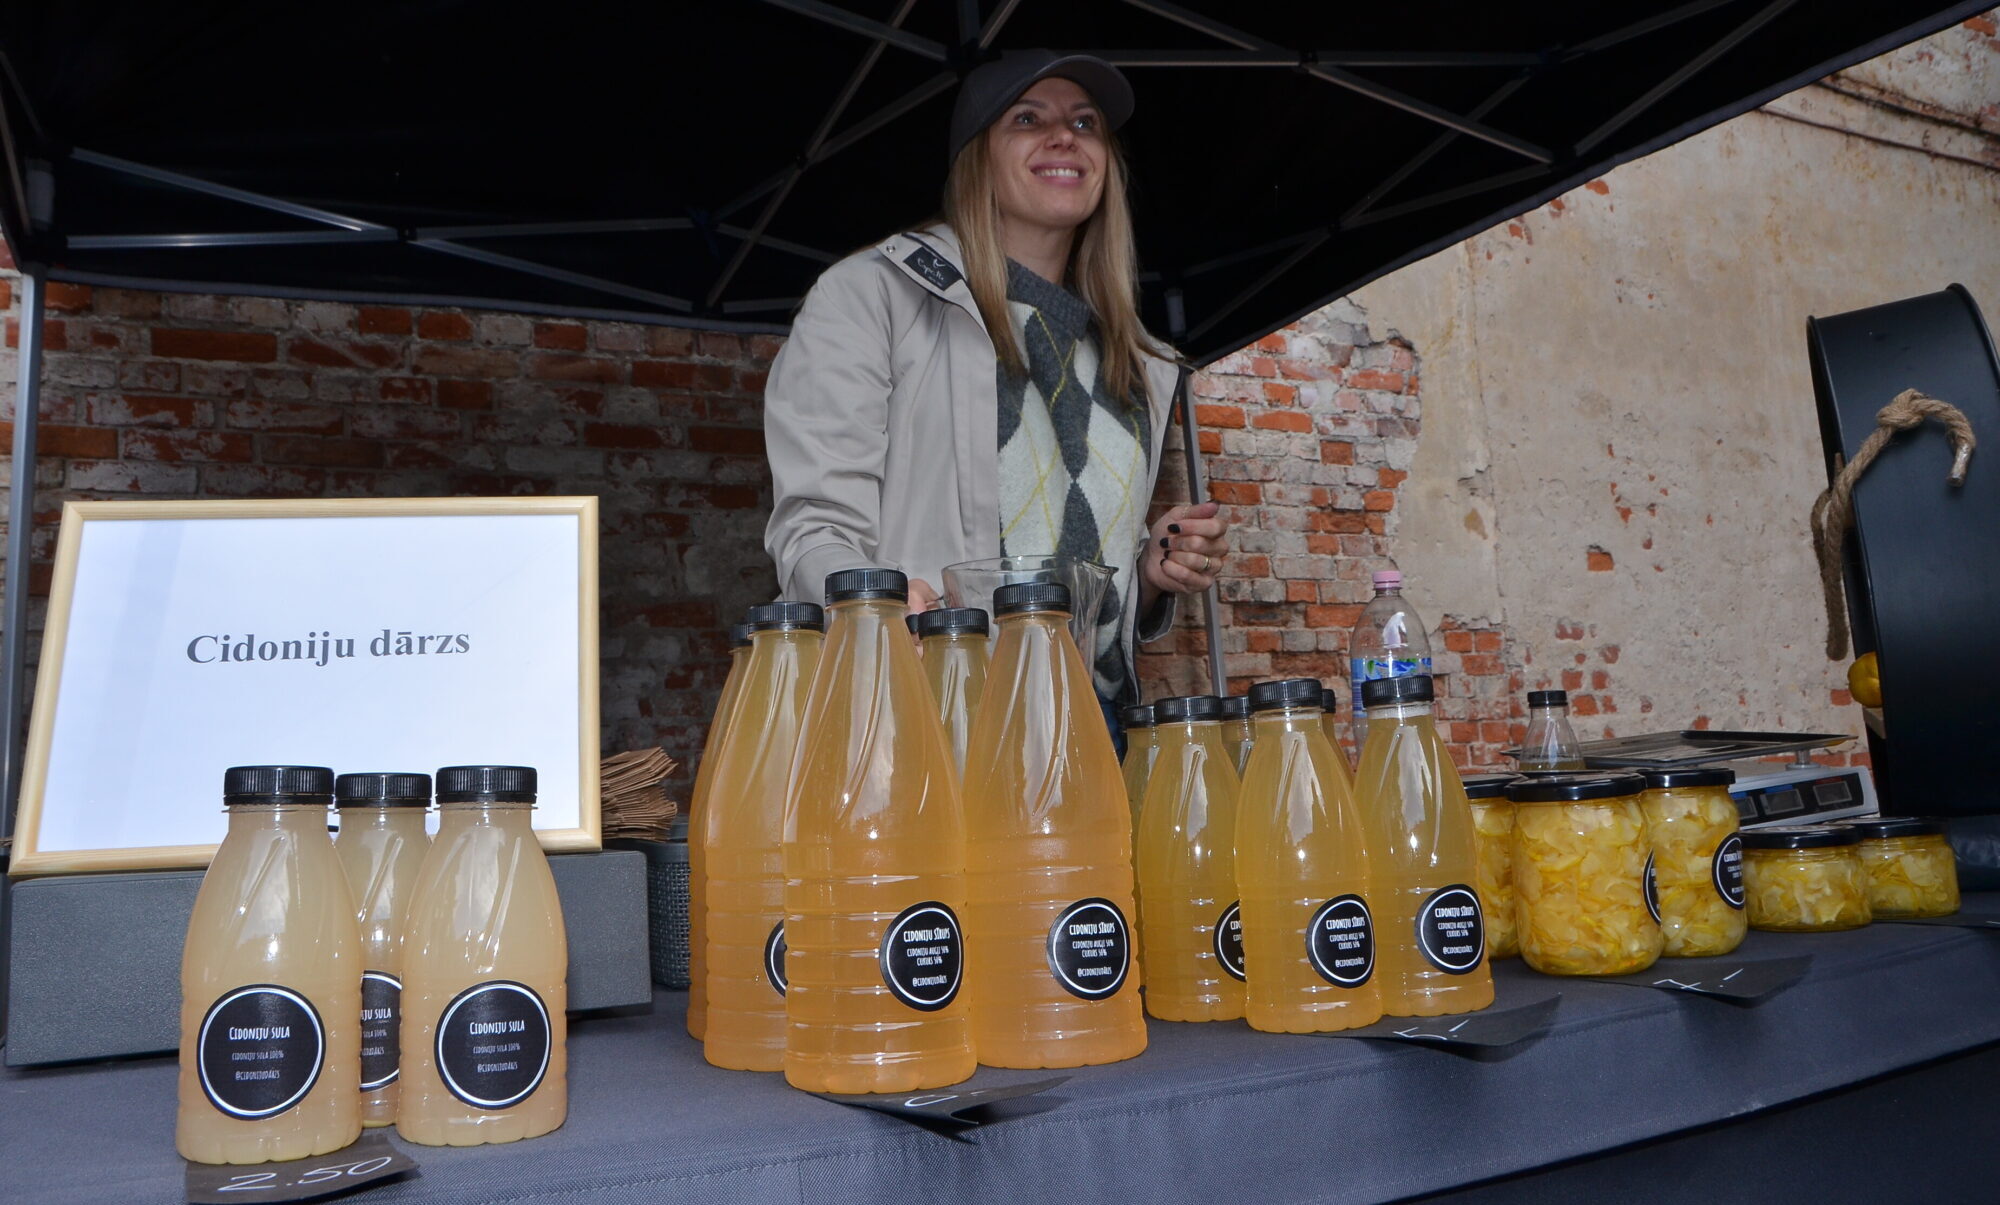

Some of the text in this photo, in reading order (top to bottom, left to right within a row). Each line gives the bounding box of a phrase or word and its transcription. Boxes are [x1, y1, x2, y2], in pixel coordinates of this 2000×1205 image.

[187, 629, 470, 667] Cidoniju dārzs
[903, 929, 933, 942] CIDONIJU
[1069, 923, 1097, 935] CIDONIJU
[374, 1007, 392, 1019] SULA
[508, 1019, 525, 1032] SULA
[271, 1026, 290, 1039] SULA
[217, 1156, 393, 1192] 2.50
